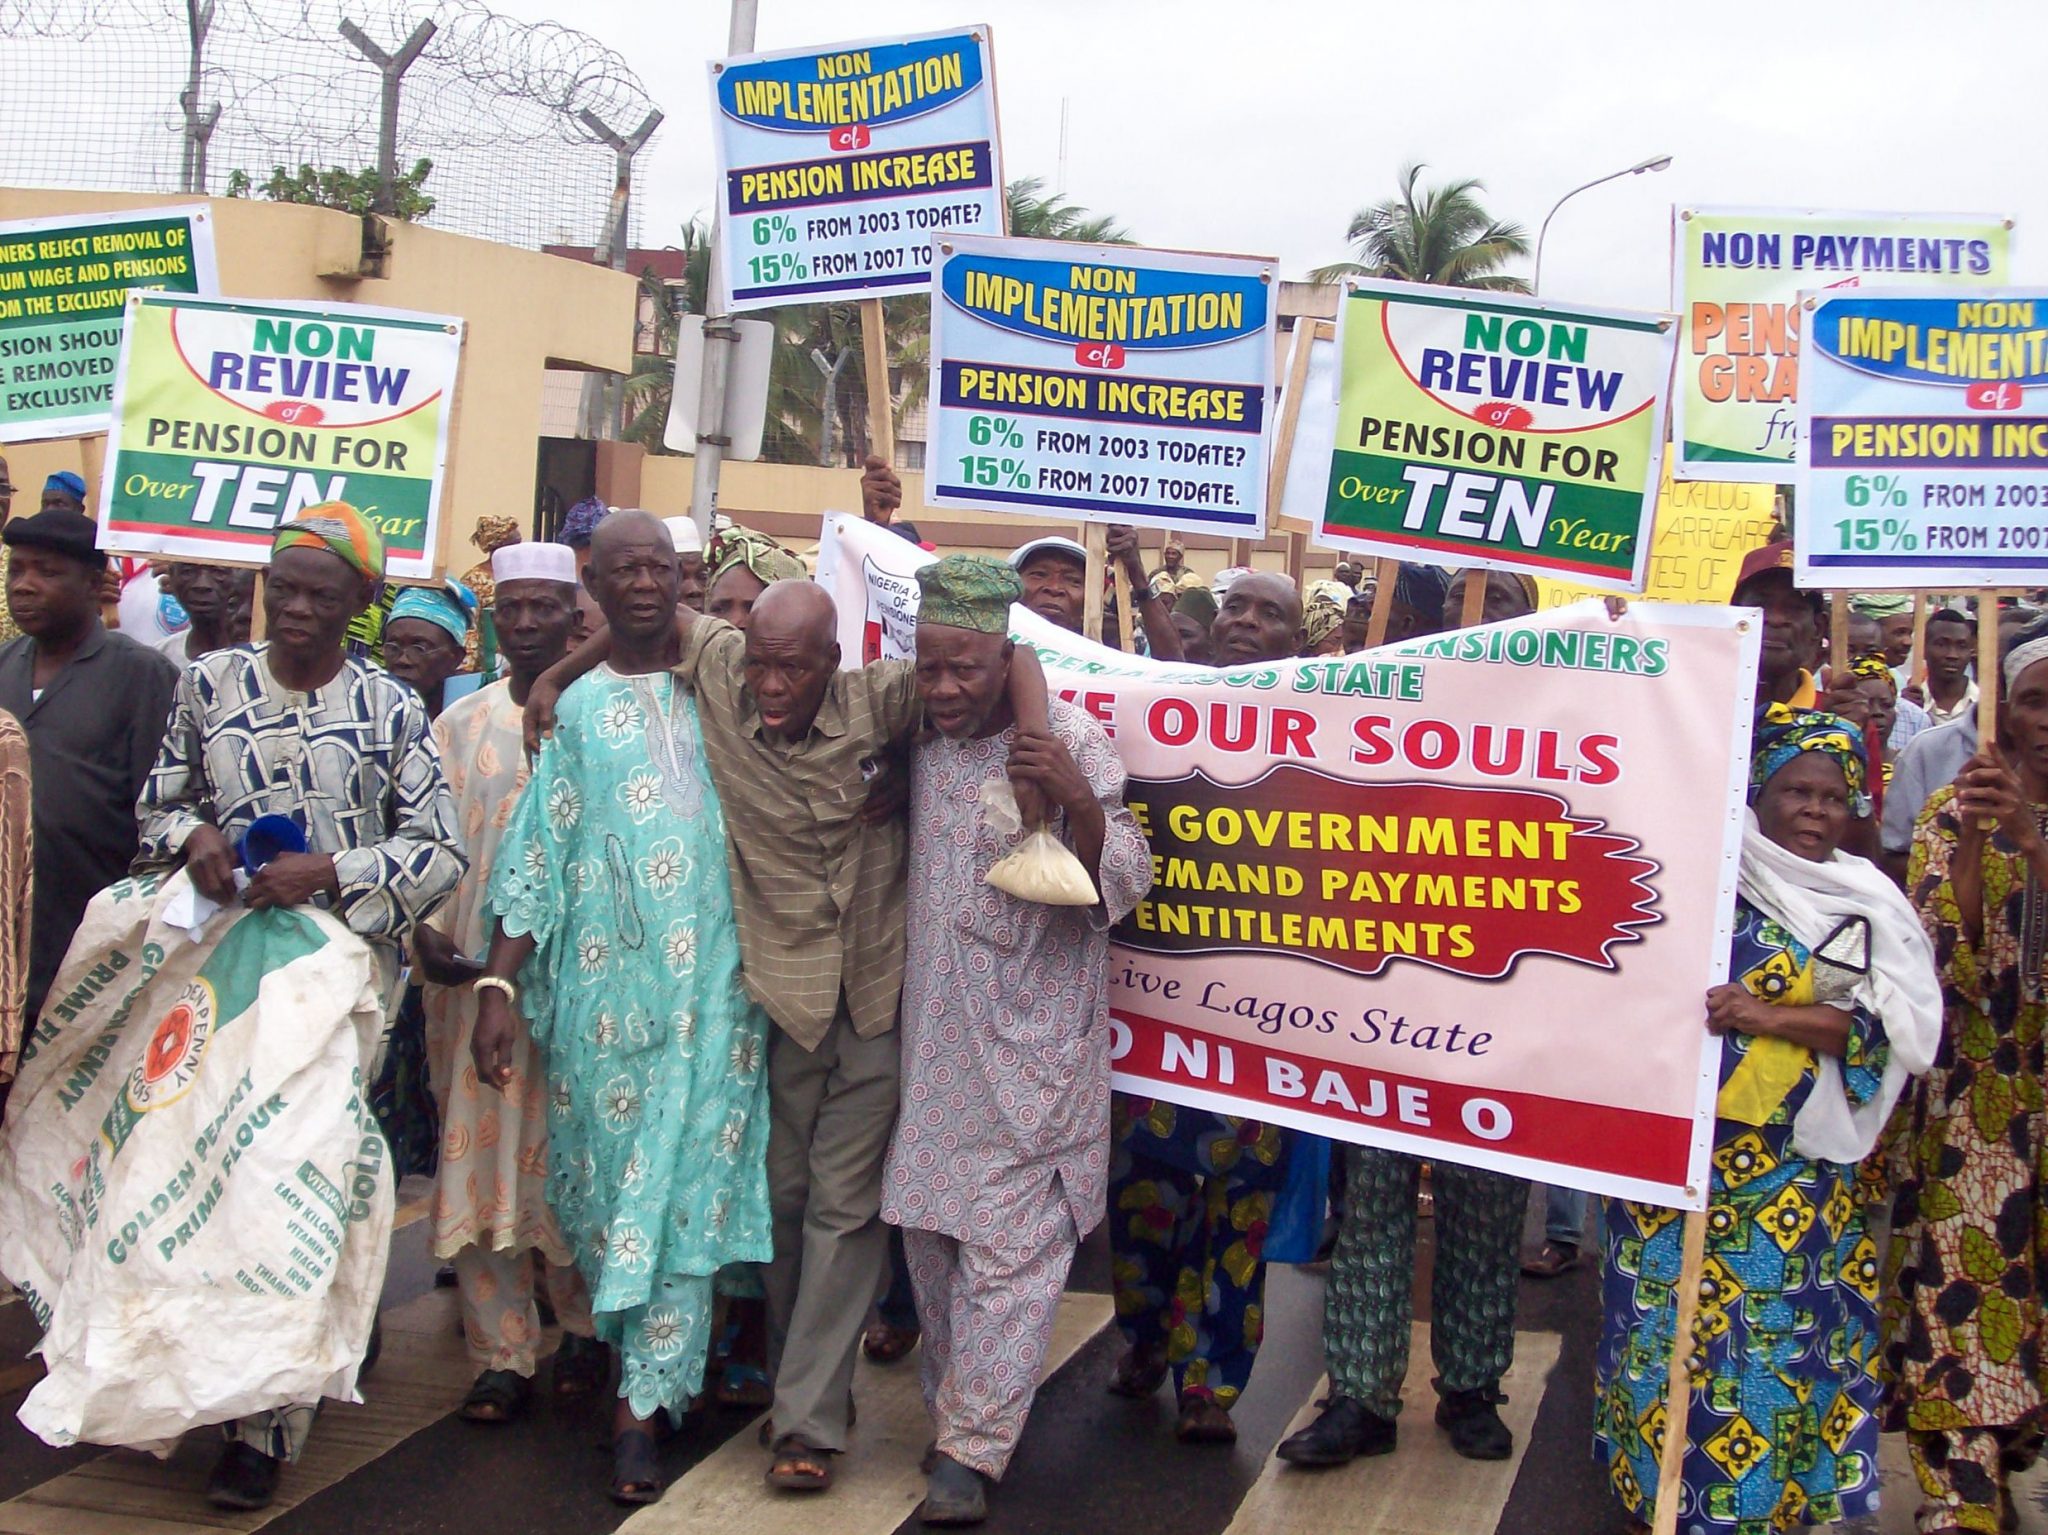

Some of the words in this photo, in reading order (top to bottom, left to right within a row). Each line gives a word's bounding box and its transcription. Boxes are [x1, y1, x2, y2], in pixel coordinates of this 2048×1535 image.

[817, 51, 871, 80] NON
[734, 52, 963, 124] IMPLEMENTATION
[840, 126, 861, 149] of
[741, 164, 843, 203] PENSION
[852, 149, 976, 191] INCREASE
[39, 237, 88, 259] REJECT
[93, 231, 162, 255] REMOVAL
[166, 228, 185, 246] OF
[752, 215, 797, 245] 6%
[807, 216, 851, 241] FROM
[859, 212, 900, 234] 2003
[906, 203, 982, 229] TODATE?
[0, 271, 26, 291] UM
[29, 267, 74, 288] WAGE
[78, 263, 109, 283] AND
[113, 256, 187, 280] PENSIONS
[748, 252, 807, 283] 15%
[812, 253, 857, 278] FROM
[864, 247, 904, 270] 2007
[1703, 232, 1780, 268] NON
[1793, 235, 1991, 275] PAYMENTS
[24, 295, 54, 315] THE
[57, 288, 130, 313] EXCLUSIV
[1070, 266, 1136, 294] NON
[965, 271, 1242, 340] IMPLEMENTATION
[1957, 302, 2033, 328] NON
[252, 319, 376, 362] NON
[1087, 344, 1114, 367] of
[1463, 314, 1588, 363] NON
[1839, 317, 2048, 379] IMPLEMENT
[13, 357, 114, 383] REMOVED
[208, 351, 411, 406] REVIEW
[1420, 348, 1623, 412] REVIEW
[7, 384, 113, 411] EXCLUSIVE
[280, 404, 302, 423] of
[960, 368, 1087, 409] PENSION
[1098, 381, 1245, 422] INCREASE
[1491, 406, 1513, 426] of
[1980, 383, 2010, 409] of
[146, 418, 316, 462] PENSION
[331, 436, 408, 471] FOR
[969, 416, 1024, 449] 6%
[1037, 430, 1090, 455] FROM
[1099, 436, 1149, 460] 2003
[1157, 441, 1246, 467] TODATE?
[1359, 417, 1526, 469] PENSION
[1540, 442, 1619, 482] FOR
[1832, 424, 1981, 458] PENSION
[125, 473, 194, 500] Over
[190, 461, 347, 529] TEN
[959, 455, 1031, 489] 15%
[1038, 468, 1092, 493] FROM
[1100, 474, 1149, 497] 2007
[1158, 479, 1240, 506] TODATE.
[1844, 475, 1907, 507] 6%
[1923, 484, 1984, 508] FROM
[1339, 476, 1406, 505] Over
[1402, 465, 1555, 548] TEN
[1834, 519, 1917, 550] 15%
[1926, 526, 1988, 550] FROM
[868, 573, 910, 597] NIGERIA
[893, 596, 908, 609] OF
[1396, 629, 1668, 677] NSIONERS
[1295, 661, 1423, 700] STATE
[1147, 697, 1317, 758] OUR
[1352, 715, 1621, 785] SOULS
[1168, 804, 1573, 860] GOVERNMENT
[1322, 869, 1581, 914] PAYMENTS
[1135, 901, 1475, 957] ENTITLEMENTS
[53, 950, 131, 1023] PRIME
[1197, 982, 1340, 1034] Lagos
[1350, 1009, 1493, 1056] State
[1161, 1032, 1234, 1084] NI
[1264, 1056, 1431, 1127] BAJE
[1461, 1098, 1513, 1140] O
[106, 1160, 197, 1265] GOLDEN
[194, 1066, 255, 1163] PENNY
[157, 1174, 224, 1263] PRIME
[221, 1092, 290, 1178] FLOUR
[274, 1183, 304, 1211] EACH
[286, 1219, 325, 1258] VITAMIN
[285, 1266, 313, 1292] IRON
[289, 1246, 323, 1279] NIACIN
